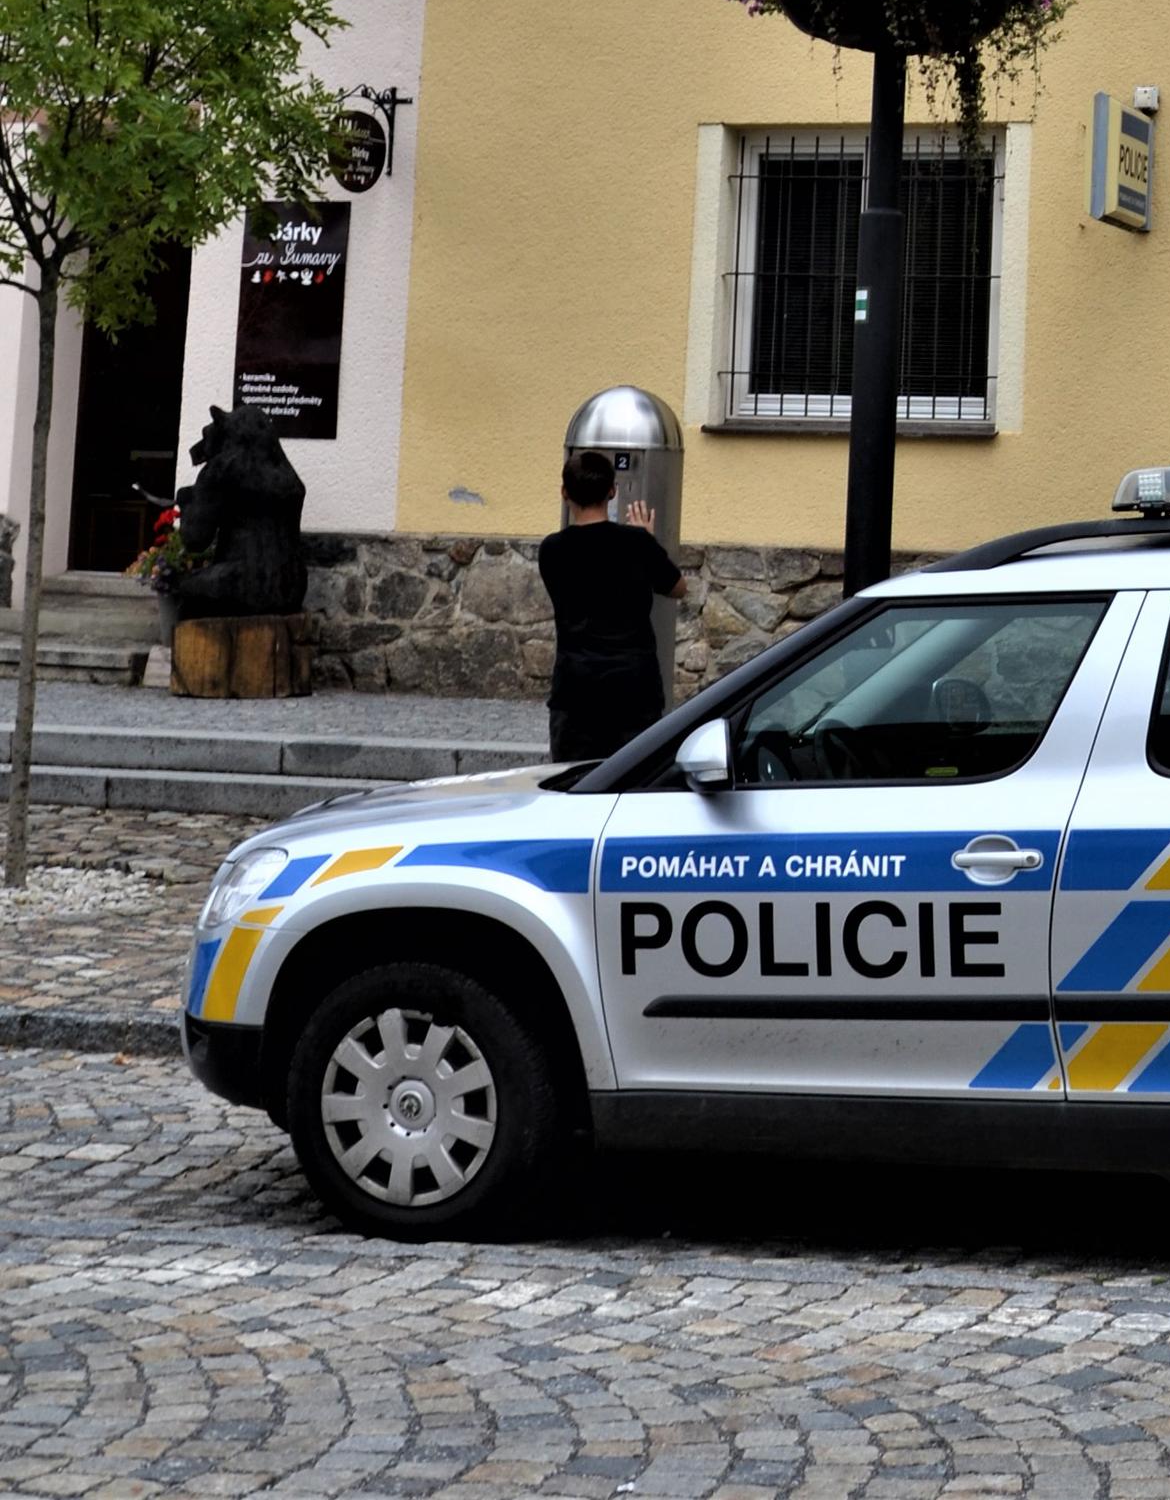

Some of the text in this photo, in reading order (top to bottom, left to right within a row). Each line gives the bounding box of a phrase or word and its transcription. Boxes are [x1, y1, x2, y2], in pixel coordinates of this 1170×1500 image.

[1119, 144, 1148, 183] POLICIE
[618, 457, 627, 469] 2
[621, 850, 906, 878] POMÁHAT A CHRÁNIT
[620, 900, 1005, 979] POLICIE
